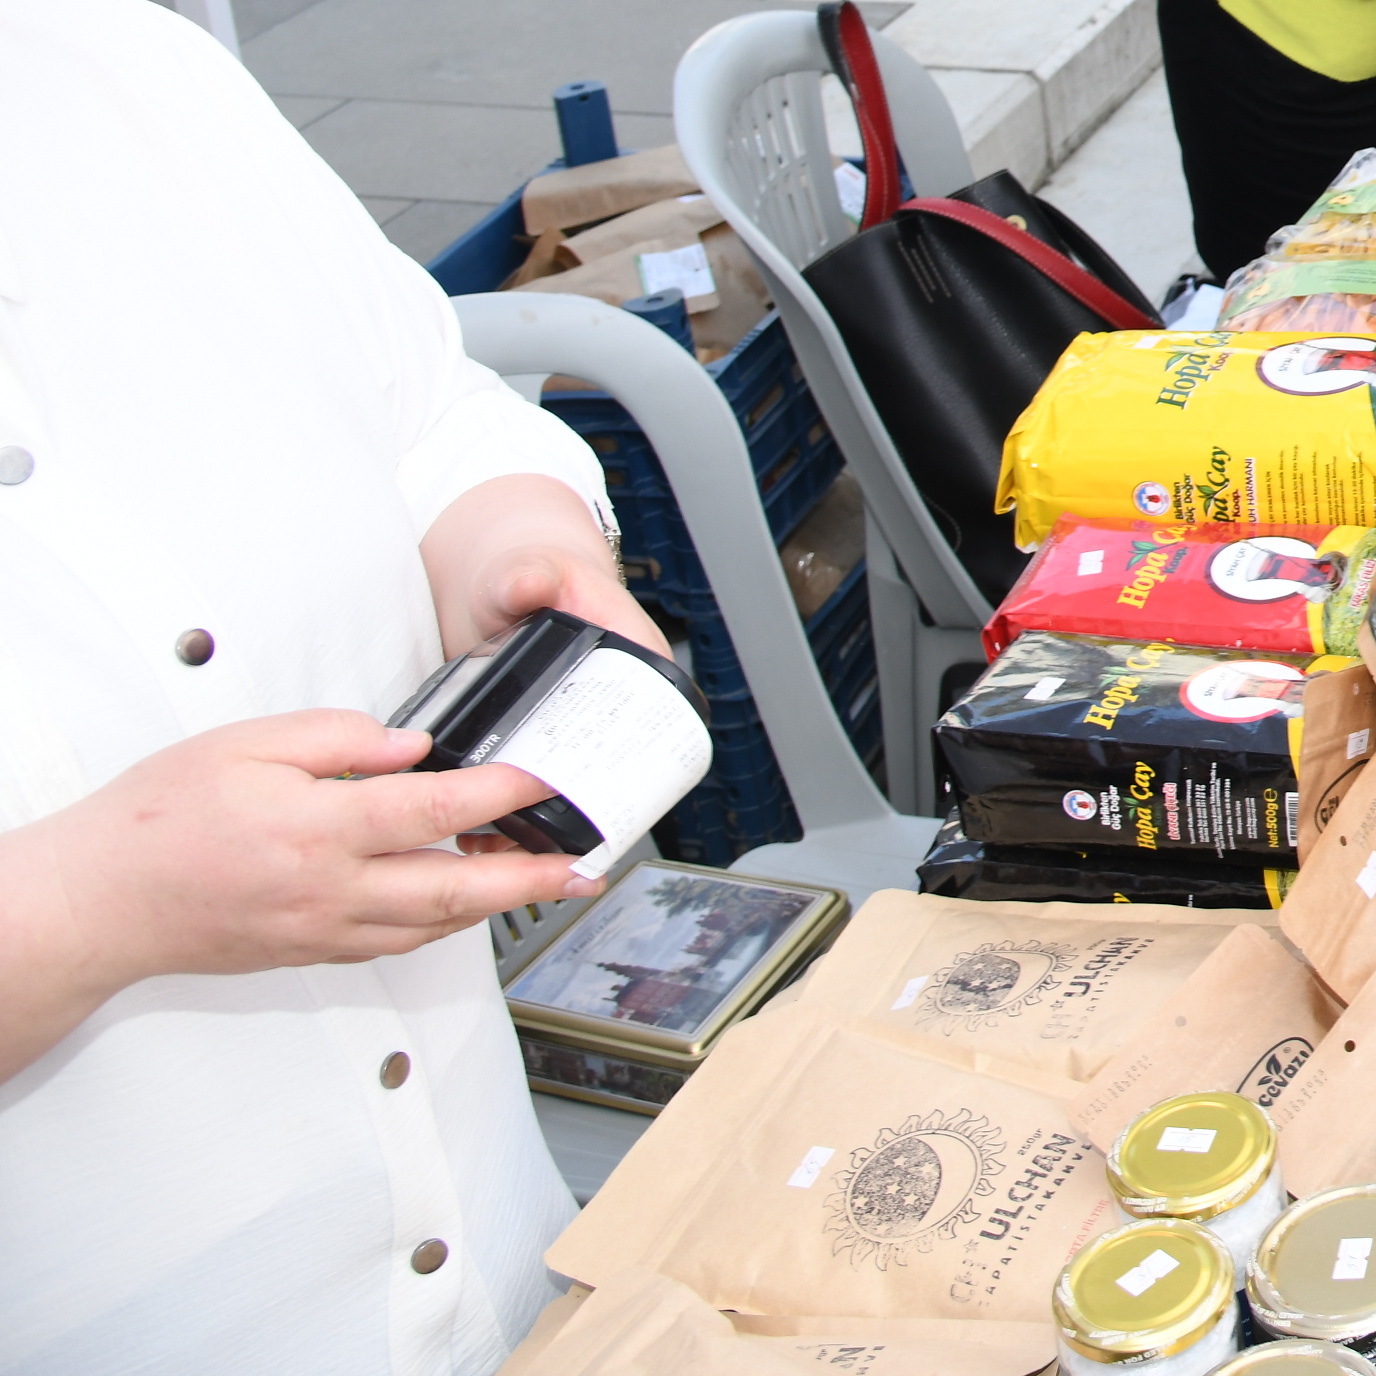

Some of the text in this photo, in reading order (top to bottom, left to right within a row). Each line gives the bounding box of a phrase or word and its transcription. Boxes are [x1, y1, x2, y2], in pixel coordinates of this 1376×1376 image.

[1155, 354, 1211, 410] Hopa
[1206, 446, 1231, 487] Çay
[1244, 458, 1254, 505] HARMANI
[1173, 482, 1184, 519] Birlikten
[1181, 474, 1196, 523] Güç Doğar
[1116, 552, 1169, 609] Hopa
[1083, 675, 1142, 730] Hopa
[465, 730, 505, 765] 300TR
[1100, 792, 1111, 826] Birlikten
[1109, 784, 1123, 830] Güç Doğar
[1129, 761, 1159, 850] Hopa Çay
[1061, 935, 1139, 999] ULCHAN
[1017, 1127, 1046, 1156] 250gr
[979, 1130, 1075, 1246] ULCHAN
